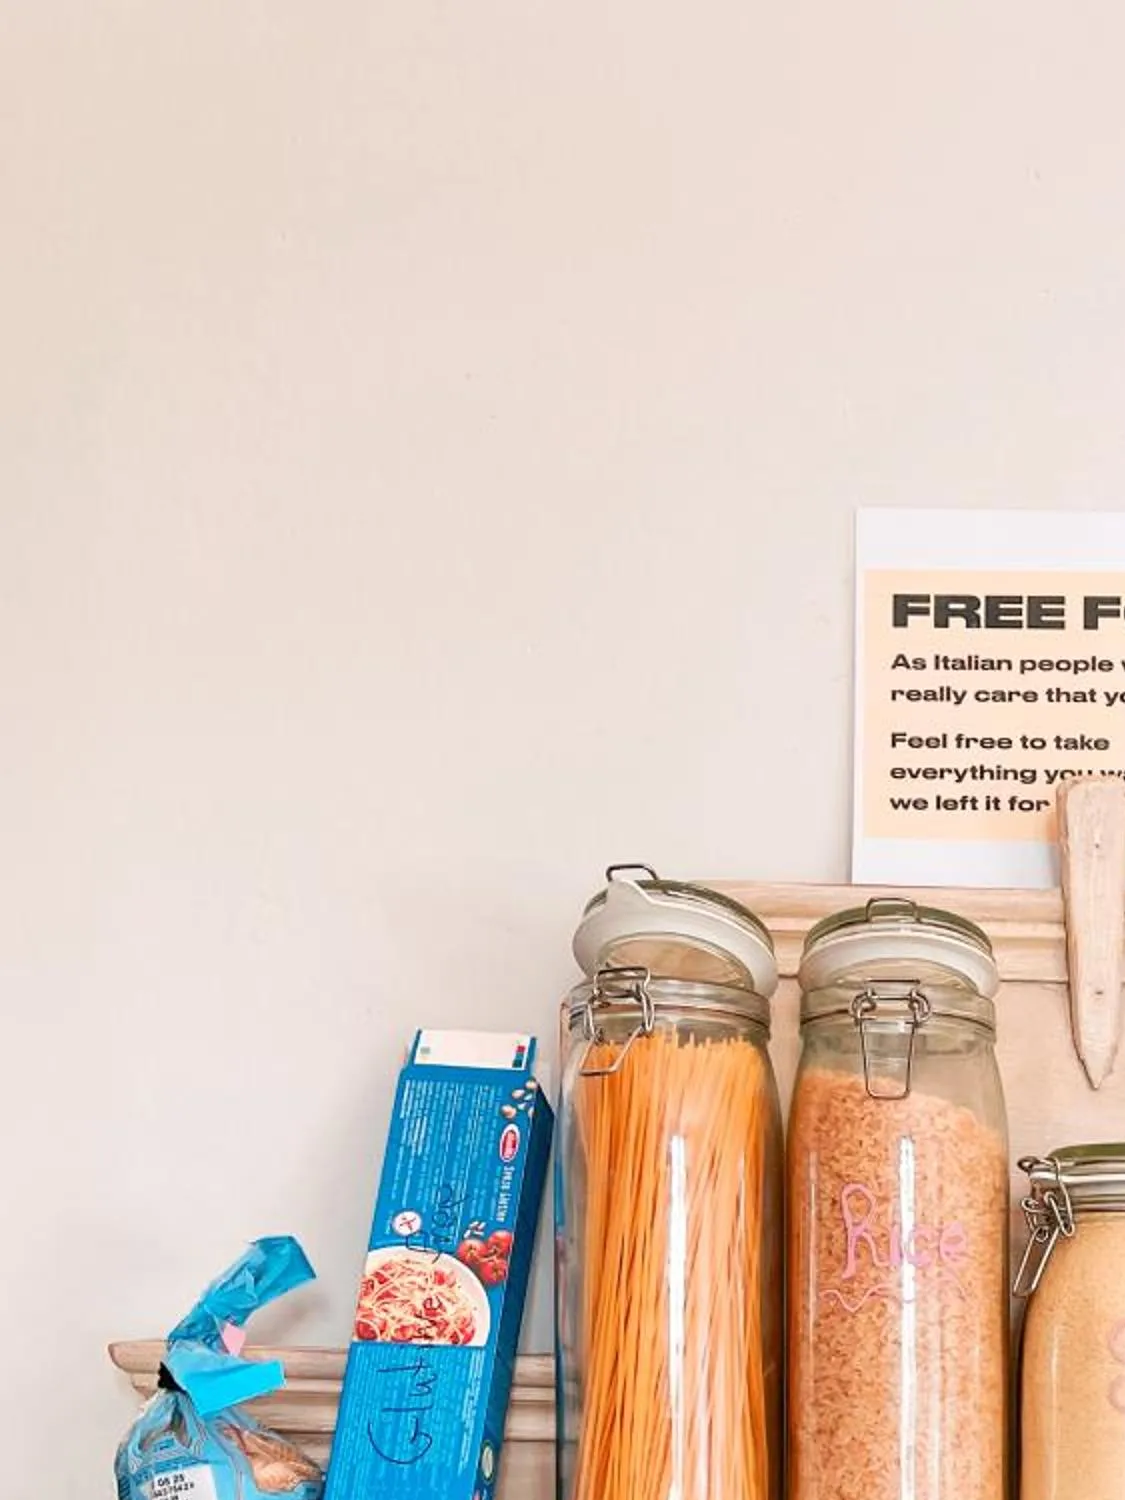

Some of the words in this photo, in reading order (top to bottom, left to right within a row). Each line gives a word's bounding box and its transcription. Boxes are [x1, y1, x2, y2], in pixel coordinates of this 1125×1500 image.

[891, 594, 1066, 630] FREE
[890, 653, 927, 671] As
[933, 655, 1013, 672] Italian
[1019, 656, 1114, 675] people
[890, 686, 967, 705] really
[974, 690, 1039, 703] care
[1045, 688, 1097, 704] that
[890, 732, 947, 749] Feel
[955, 733, 1013, 750] free
[1019, 736, 1047, 750] to
[1053, 735, 1110, 751] take
[889, 765, 1037, 784] everything
[889, 798, 929, 811] we
[935, 796, 979, 812] left
[985, 796, 1001, 812] it
[1008, 796, 1050, 812] for
